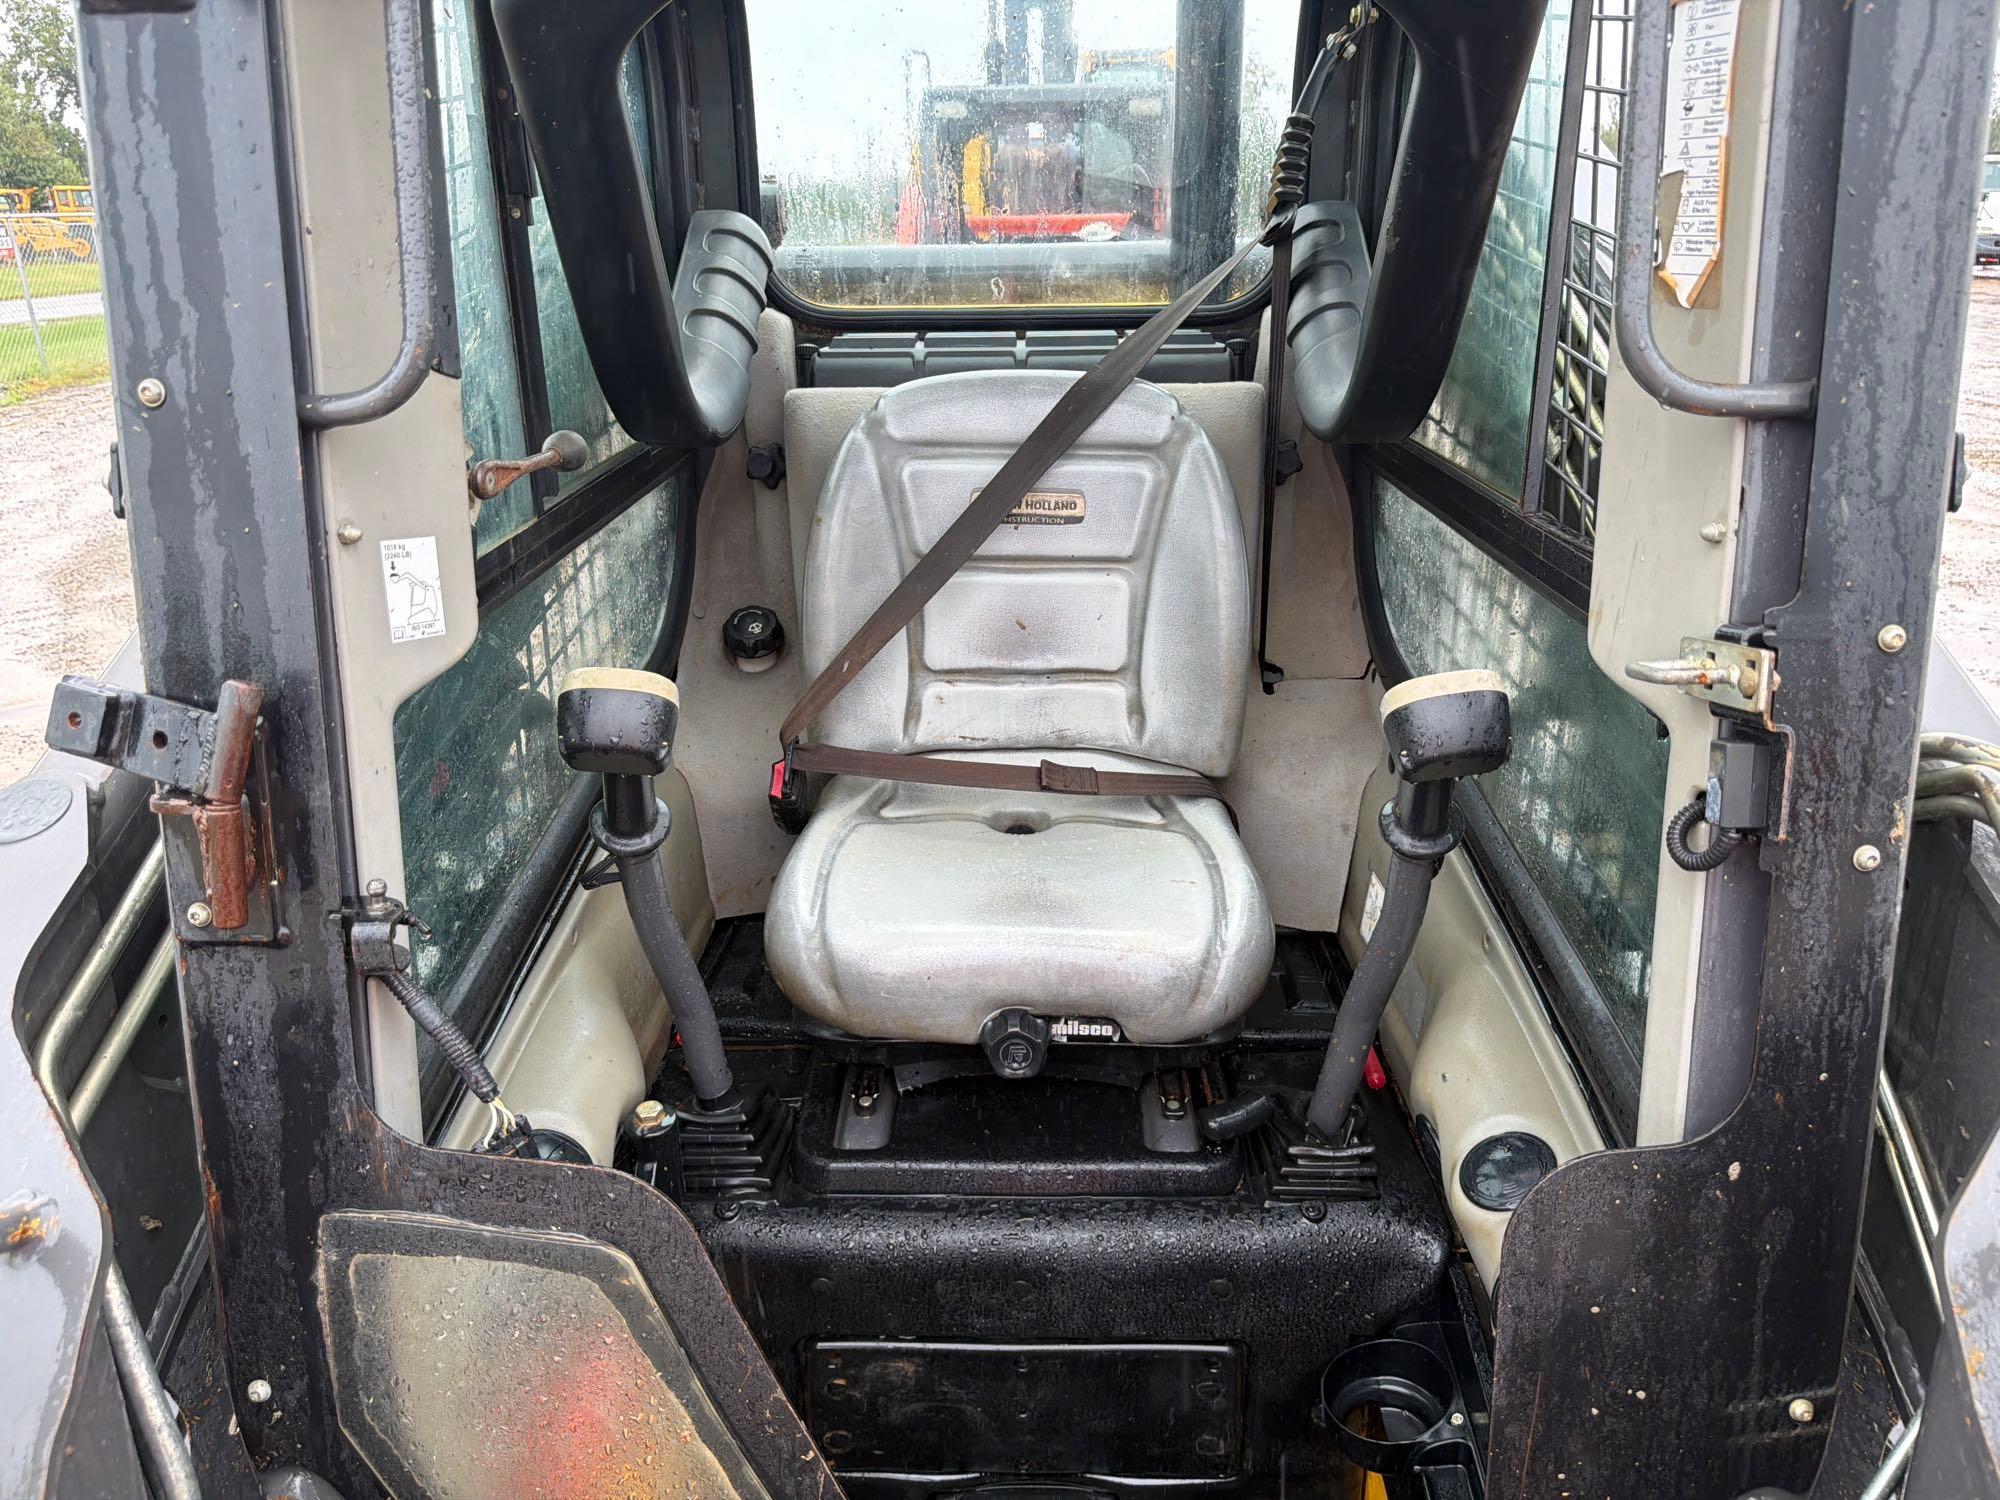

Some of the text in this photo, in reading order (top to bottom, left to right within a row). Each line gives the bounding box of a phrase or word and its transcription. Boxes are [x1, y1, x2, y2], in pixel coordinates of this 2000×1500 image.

[1025, 500, 1077, 511] HOLLAND
[1004, 516, 1065, 524] NSTRUCTION
[398, 543, 406, 551] kg
[401, 550, 412, 559] LB)
[411, 624, 421, 632] ISO
[1051, 1020, 1113, 1036] milsco
